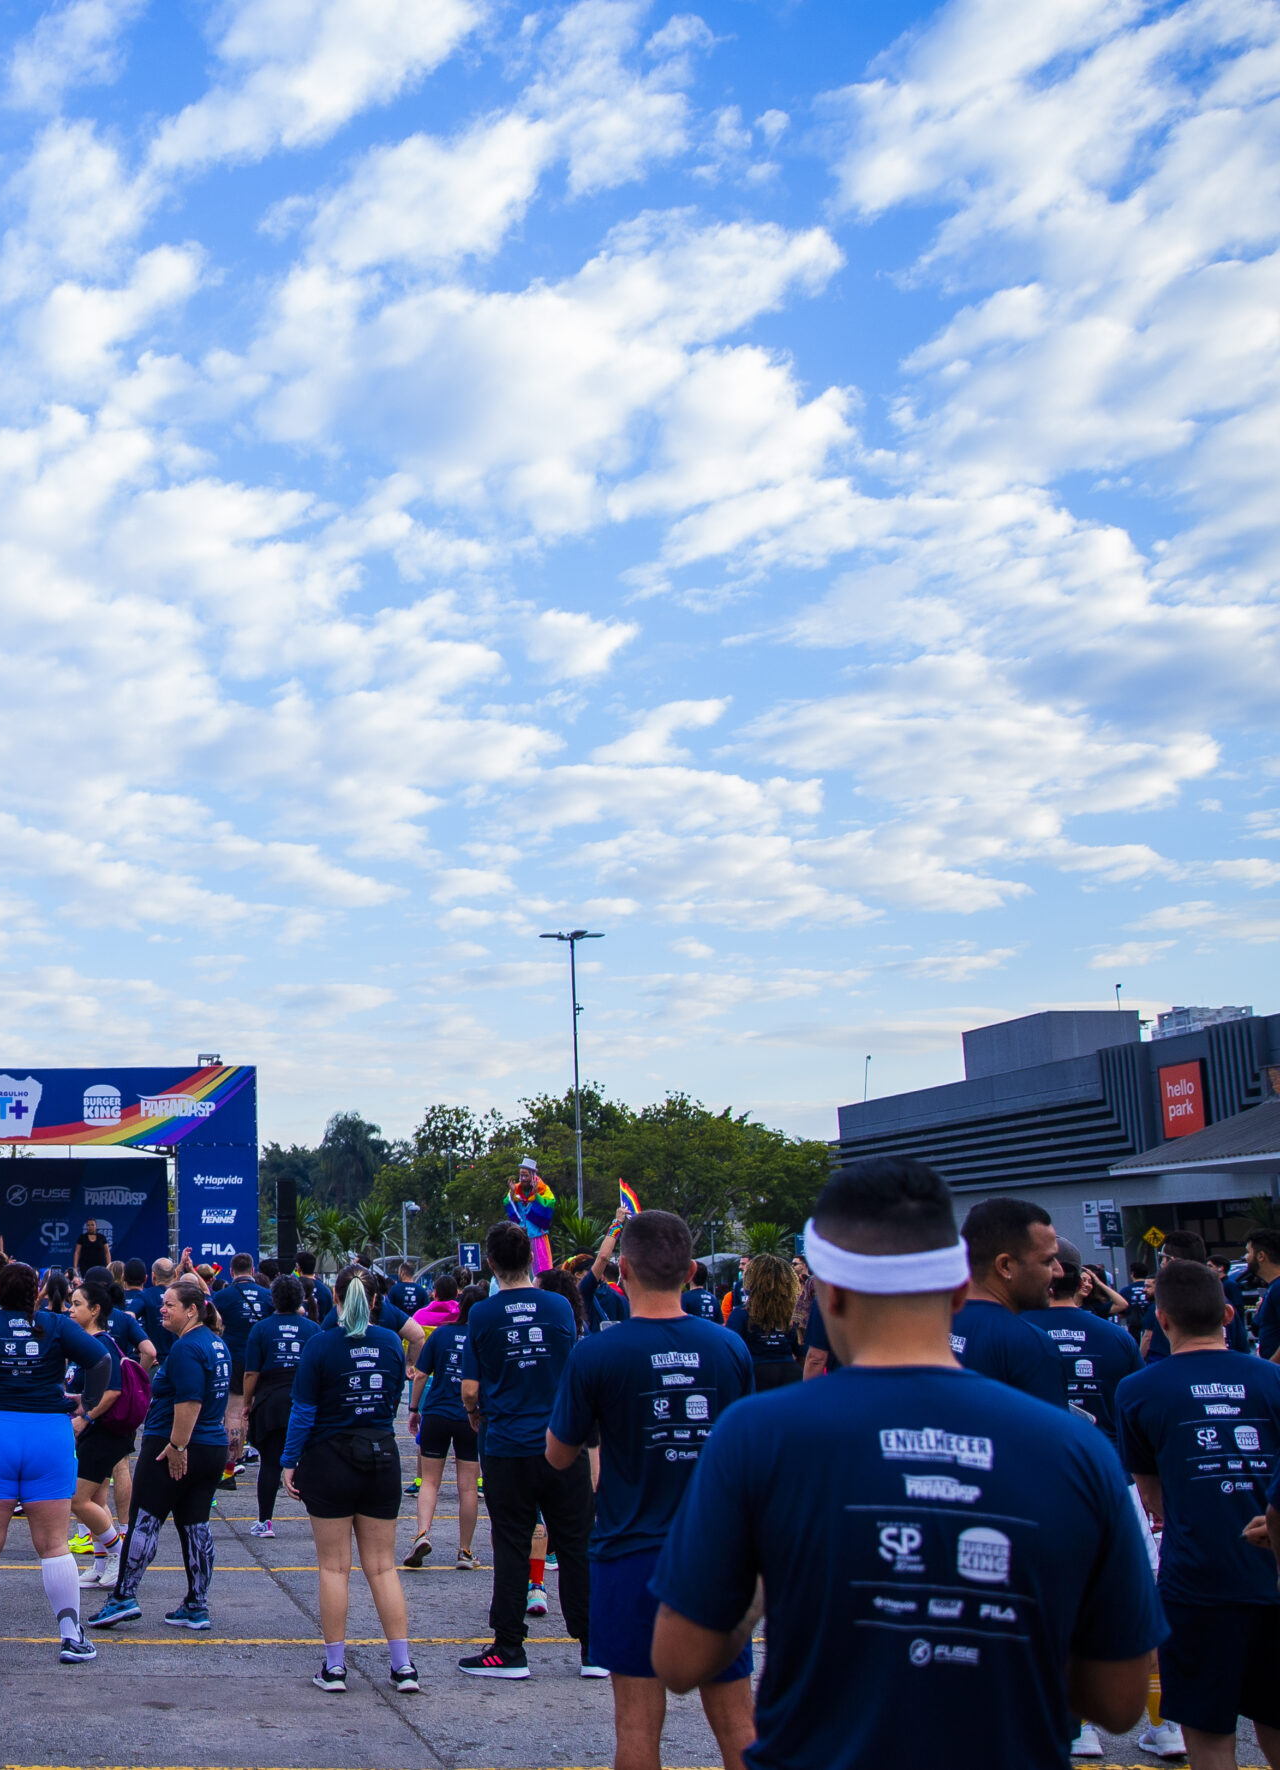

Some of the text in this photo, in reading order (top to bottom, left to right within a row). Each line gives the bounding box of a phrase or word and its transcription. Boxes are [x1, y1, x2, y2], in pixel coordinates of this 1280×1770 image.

[1166, 1079, 1194, 1098] hello
[83, 1097, 122, 1106] BURGER
[140, 1099, 216, 1117] PARADASP
[83, 1106, 122, 1118] KING
[1168, 1099, 1194, 1121] park
[205, 1175, 243, 1186] Hapvida
[31, 1188, 71, 1199] FUSE
[201, 1216, 235, 1224] TENNIS
[40, 1222, 70, 1246] SP
[201, 1243, 236, 1256] FILA
[1191, 1384, 1245, 1396] ENVELHECER
[686, 1407, 708, 1416] KING
[880, 1429, 993, 1457] ENVELHECER
[1236, 1438, 1259, 1446] KING
[879, 1527, 921, 1561] SP
[959, 1542, 1009, 1558] BURGER
[958, 1553, 1010, 1573] KING
[979, 1604, 1016, 1622] FILA
[933, 1644, 979, 1660] FUSE
